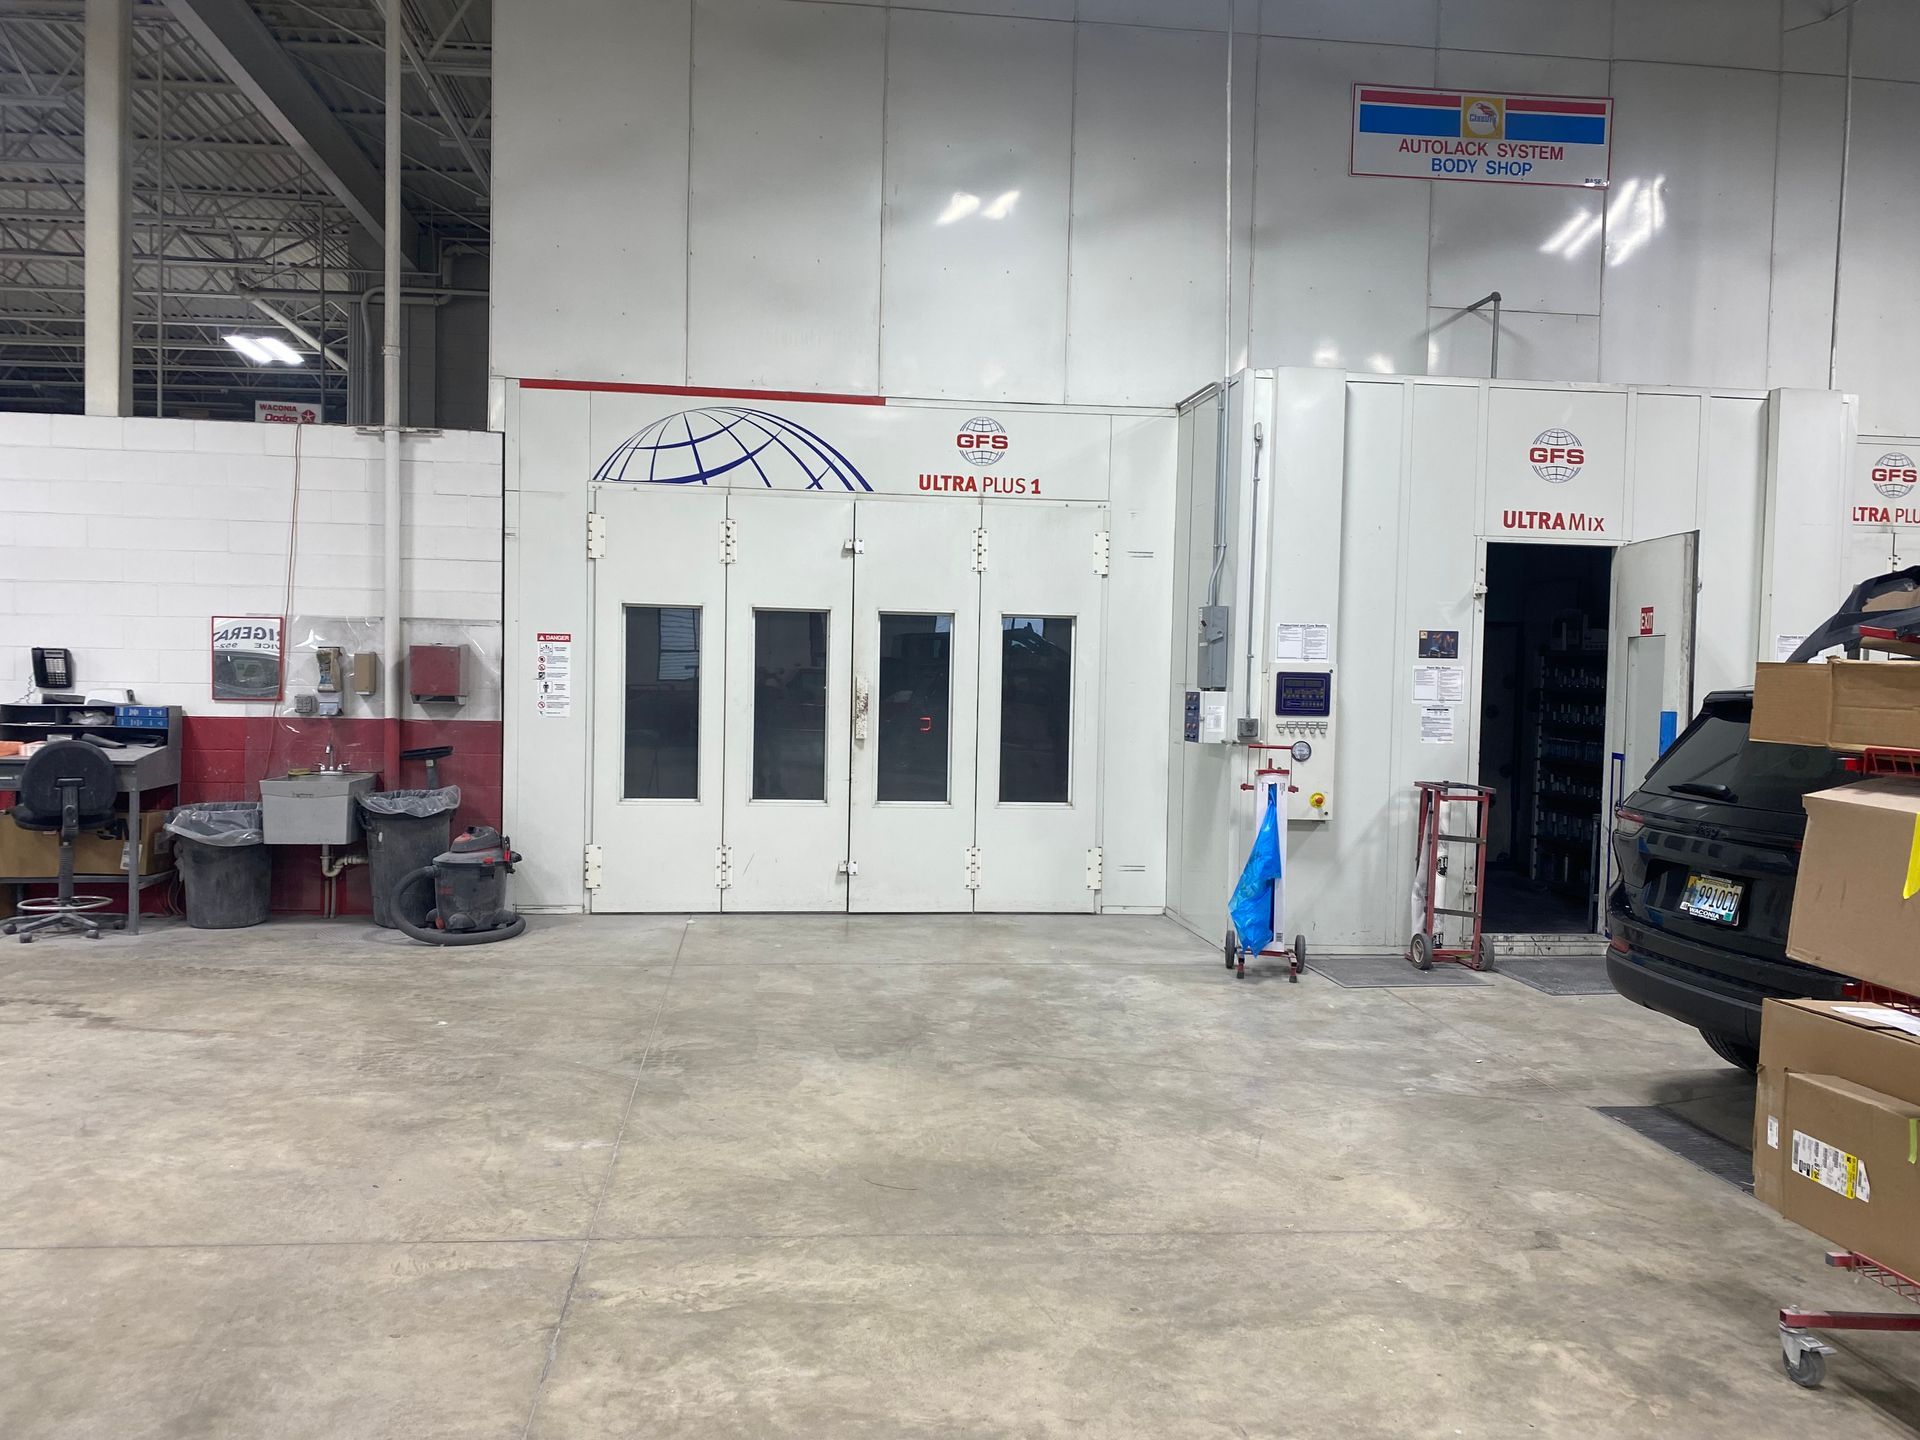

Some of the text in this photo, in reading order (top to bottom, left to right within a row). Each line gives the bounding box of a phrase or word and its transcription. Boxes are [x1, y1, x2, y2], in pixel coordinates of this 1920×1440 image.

[1398, 138, 1564, 161] AUTOLACK SYSTEM
[1431, 157, 1533, 177] BODY SHOP
[259, 404, 297, 412] WACONIA
[265, 413, 298, 423] Dodge
[956, 433, 1009, 450] GFS
[1529, 447, 1585, 465] GFS
[1871, 468, 1918, 483] GFS
[919, 474, 1041, 495] ULTRA PLUS 1
[1641, 612, 1654, 630] EXIT
[1690, 907, 1720, 920] WACONIA
